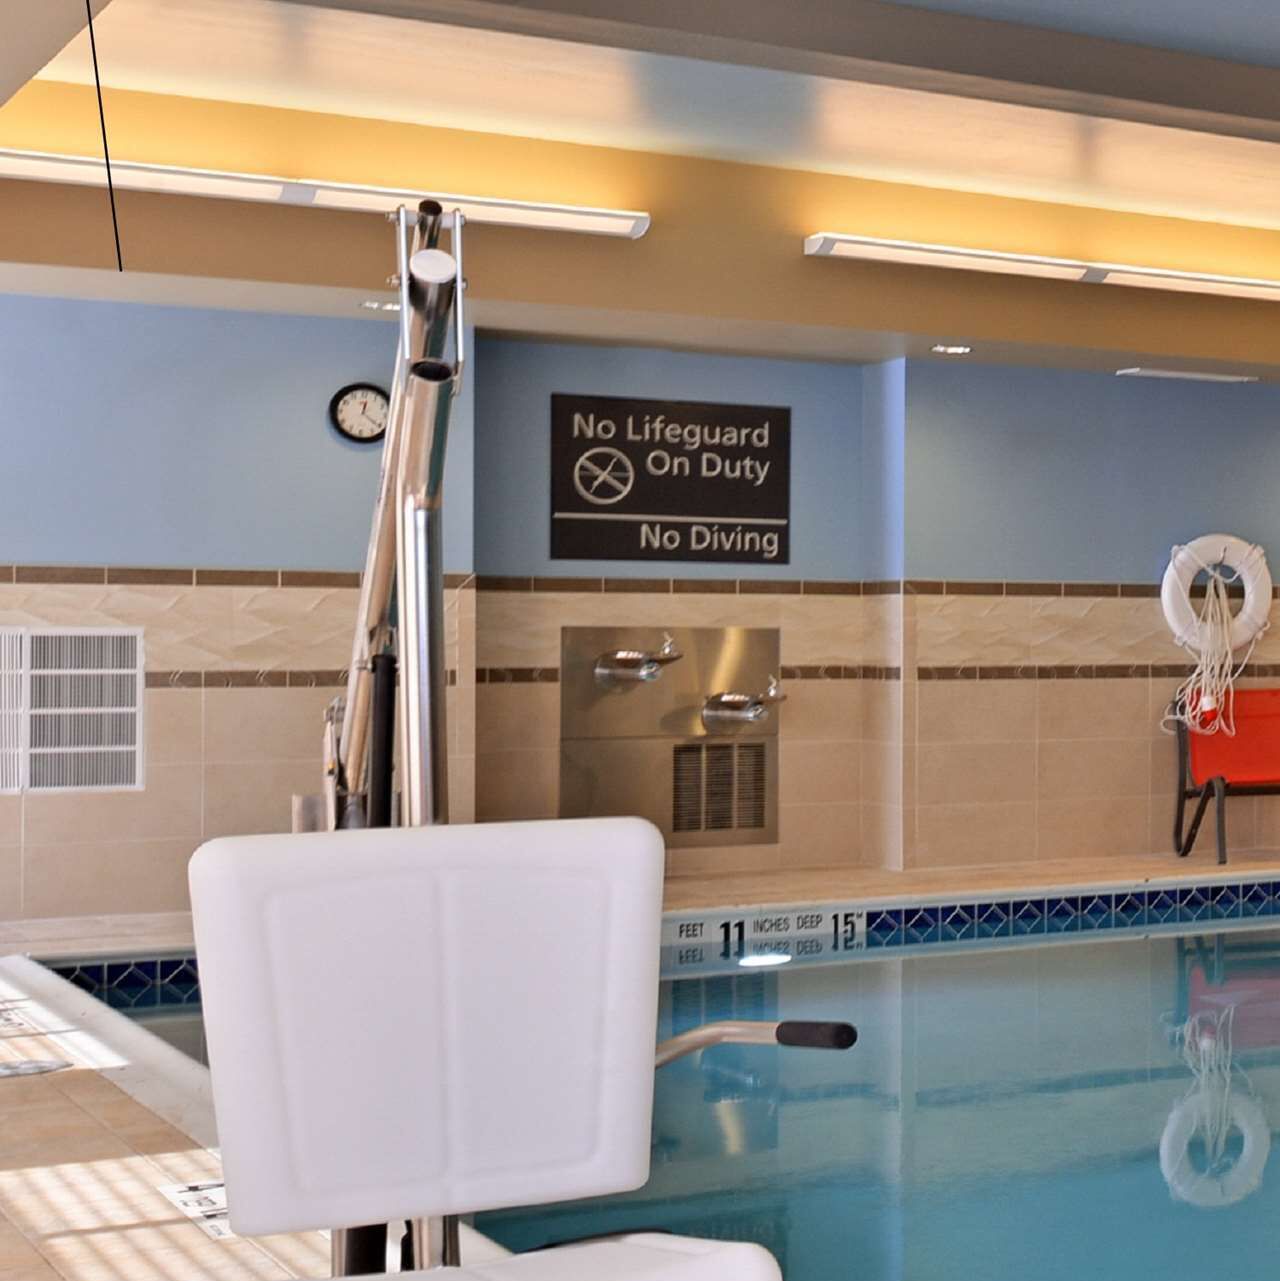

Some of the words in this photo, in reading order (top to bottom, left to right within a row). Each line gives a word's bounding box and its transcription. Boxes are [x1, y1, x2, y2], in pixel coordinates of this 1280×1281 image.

[572, 412, 616, 440] No
[627, 415, 770, 450] Lifeguard
[646, 449, 690, 476] On
[701, 452, 770, 487] Duty
[640, 523, 681, 550] No
[690, 524, 779, 558] Diving
[678, 923, 704, 938] FEET
[753, 915, 790, 933] INCHES
[796, 914, 823, 930] DEEP
